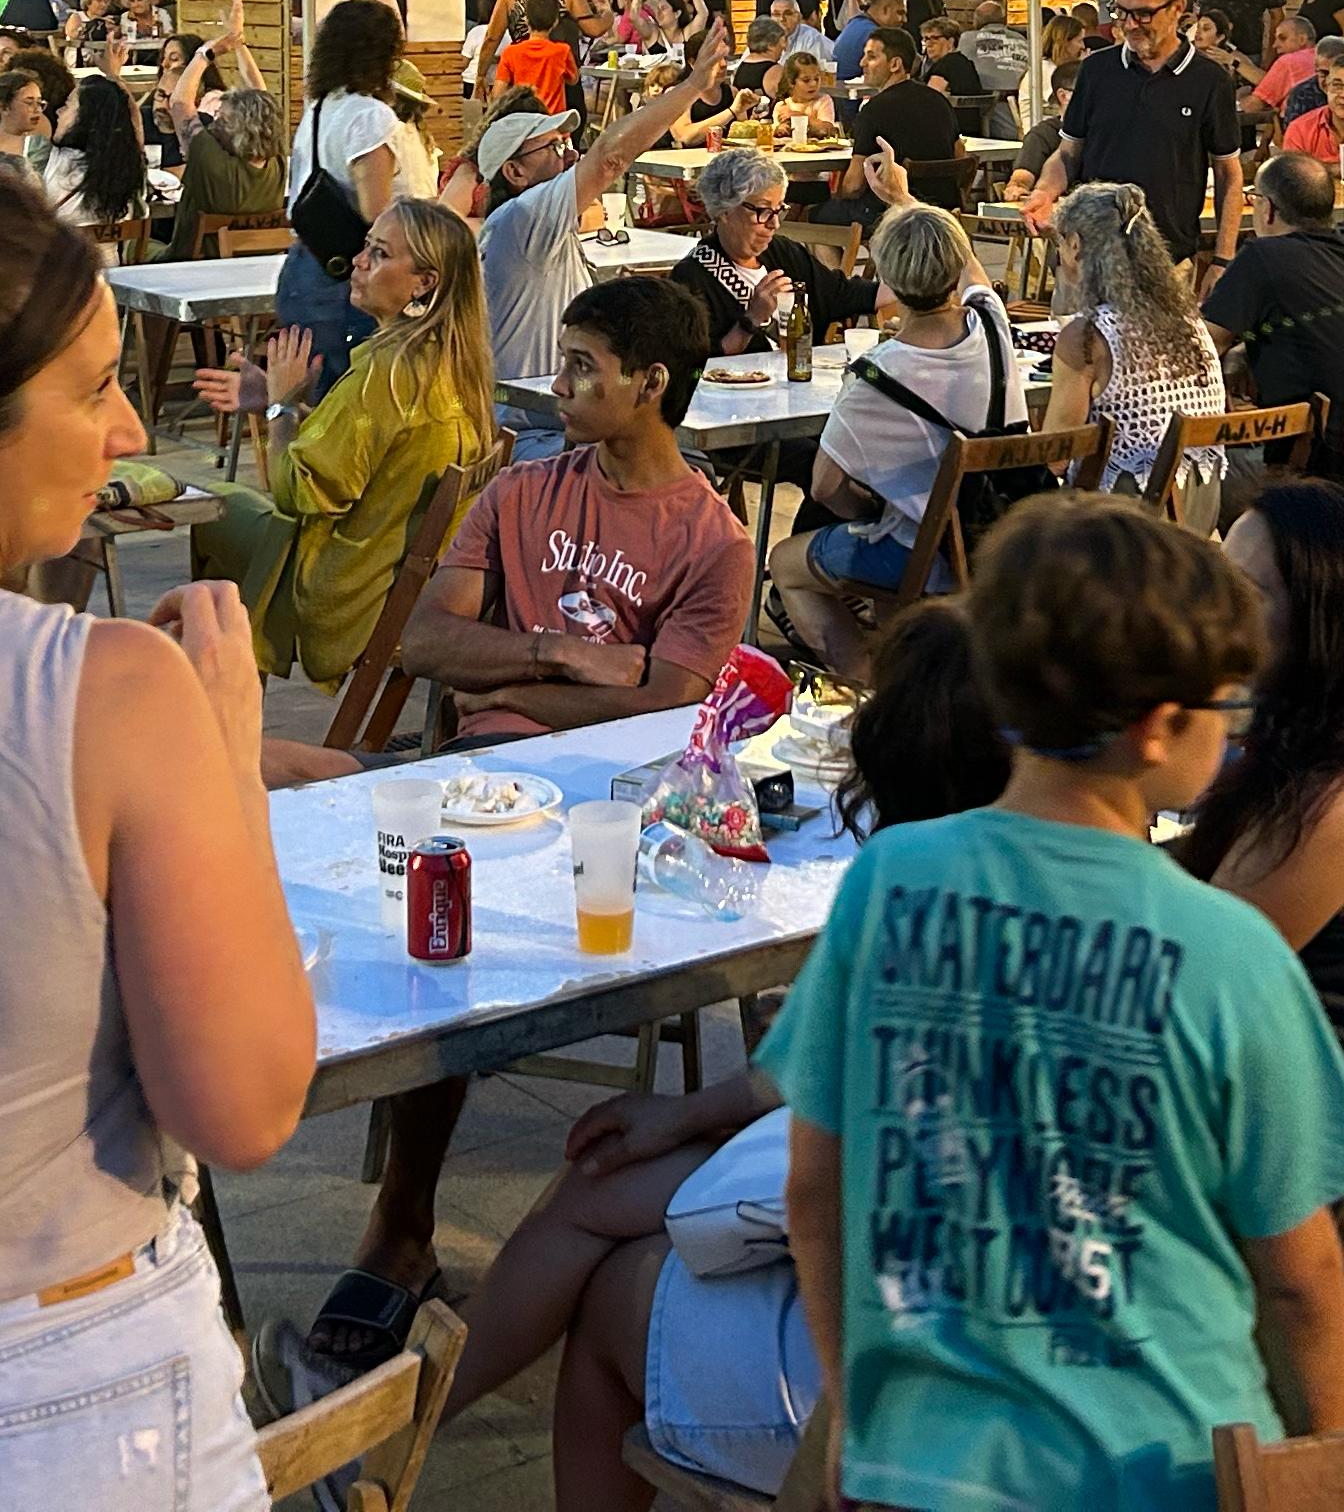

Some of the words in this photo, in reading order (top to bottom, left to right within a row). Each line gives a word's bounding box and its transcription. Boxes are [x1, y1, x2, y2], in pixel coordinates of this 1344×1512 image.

[602, 549, 647, 607] Inc.
[377, 830, 405, 847] FIRA
[379, 858, 406, 876] Bee
[428, 879, 453, 954] Enrique
[882, 886, 1184, 1034] SKATEBOARD
